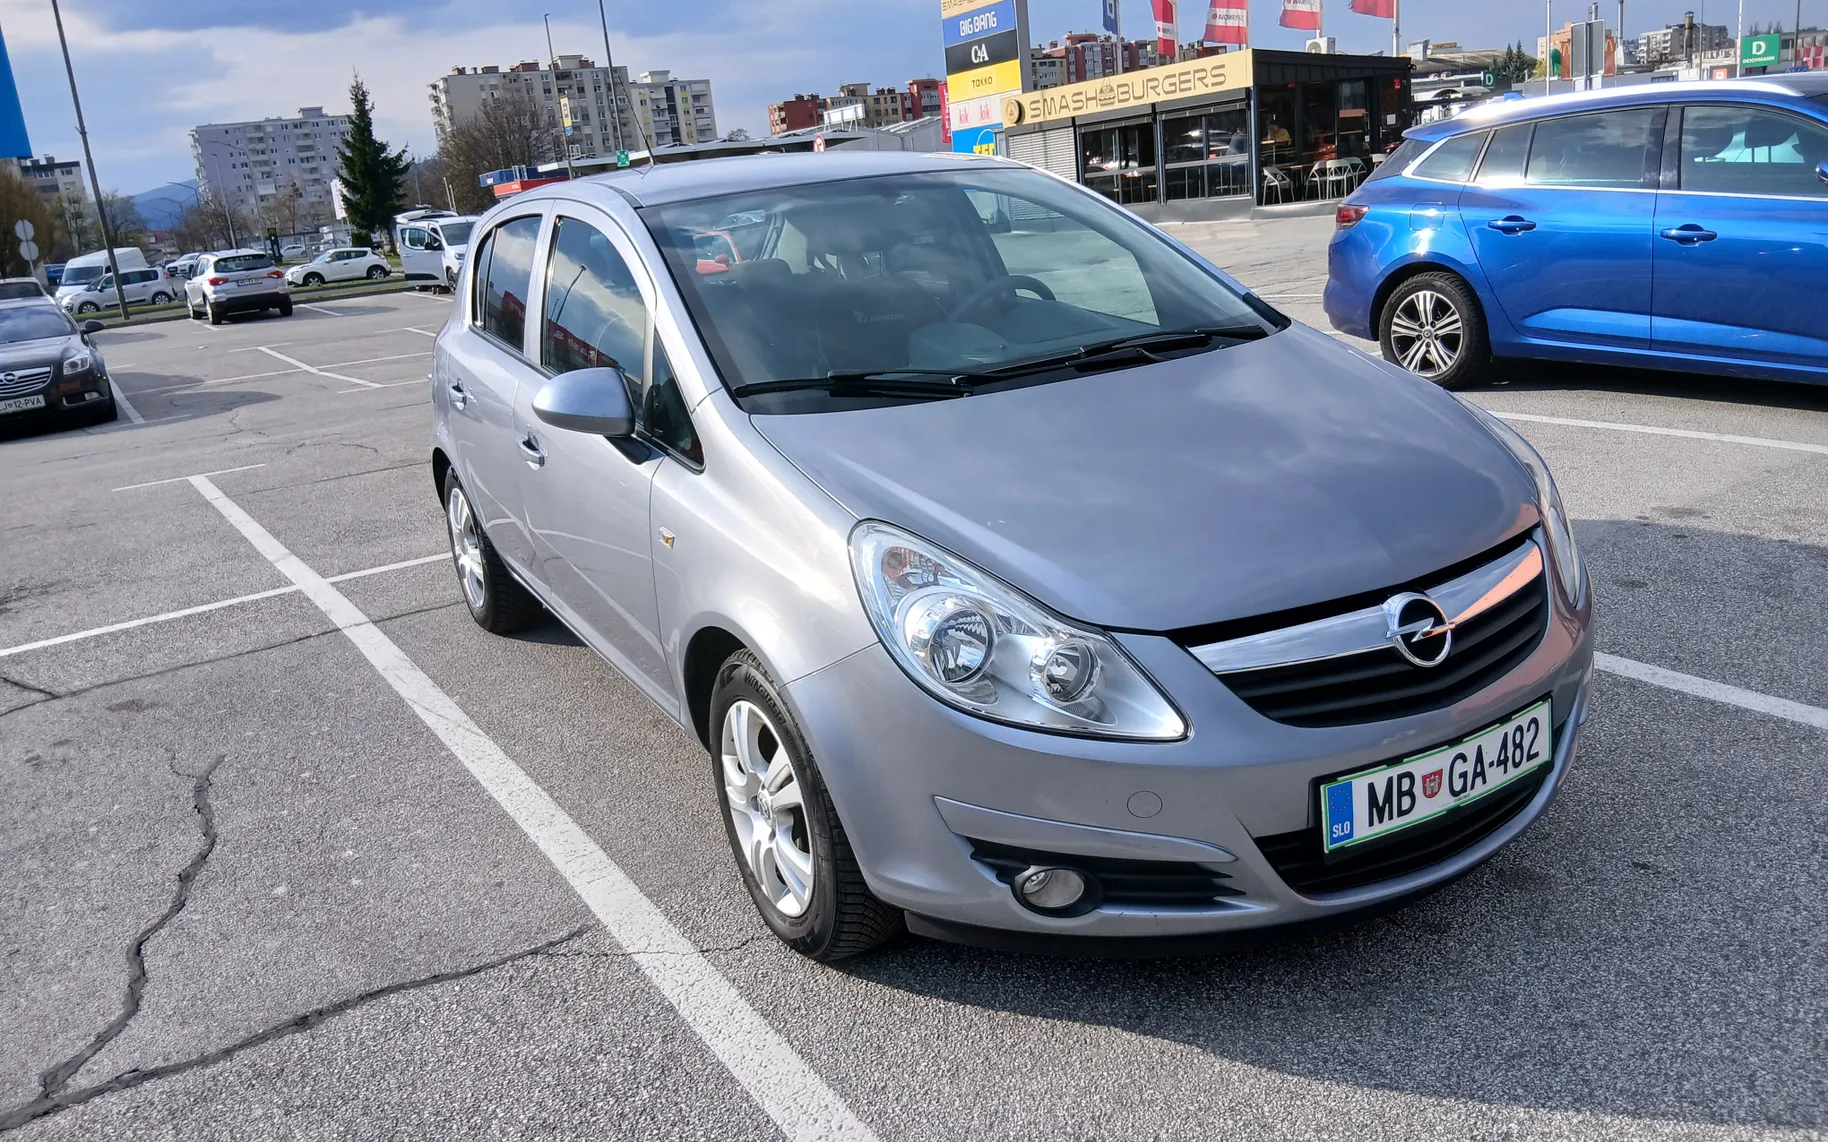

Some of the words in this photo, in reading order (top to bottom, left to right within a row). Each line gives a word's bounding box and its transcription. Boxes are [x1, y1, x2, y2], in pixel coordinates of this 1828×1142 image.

[960, 19, 973, 37] BIG
[974, 11, 997, 33] BANG
[1752, 41, 1766, 55] D
[1742, 56, 1775, 64] DEICHMANN
[972, 76, 993, 88] TOKKO
[1029, 91, 1099, 119] SMASH
[1117, 64, 1227, 104] BURGERS
[744, 671, 786, 725] WINGUARD
[1367, 770, 1416, 827] MB
[1448, 716, 1540, 798] GA-482
[1332, 820, 1350, 838] SLO
